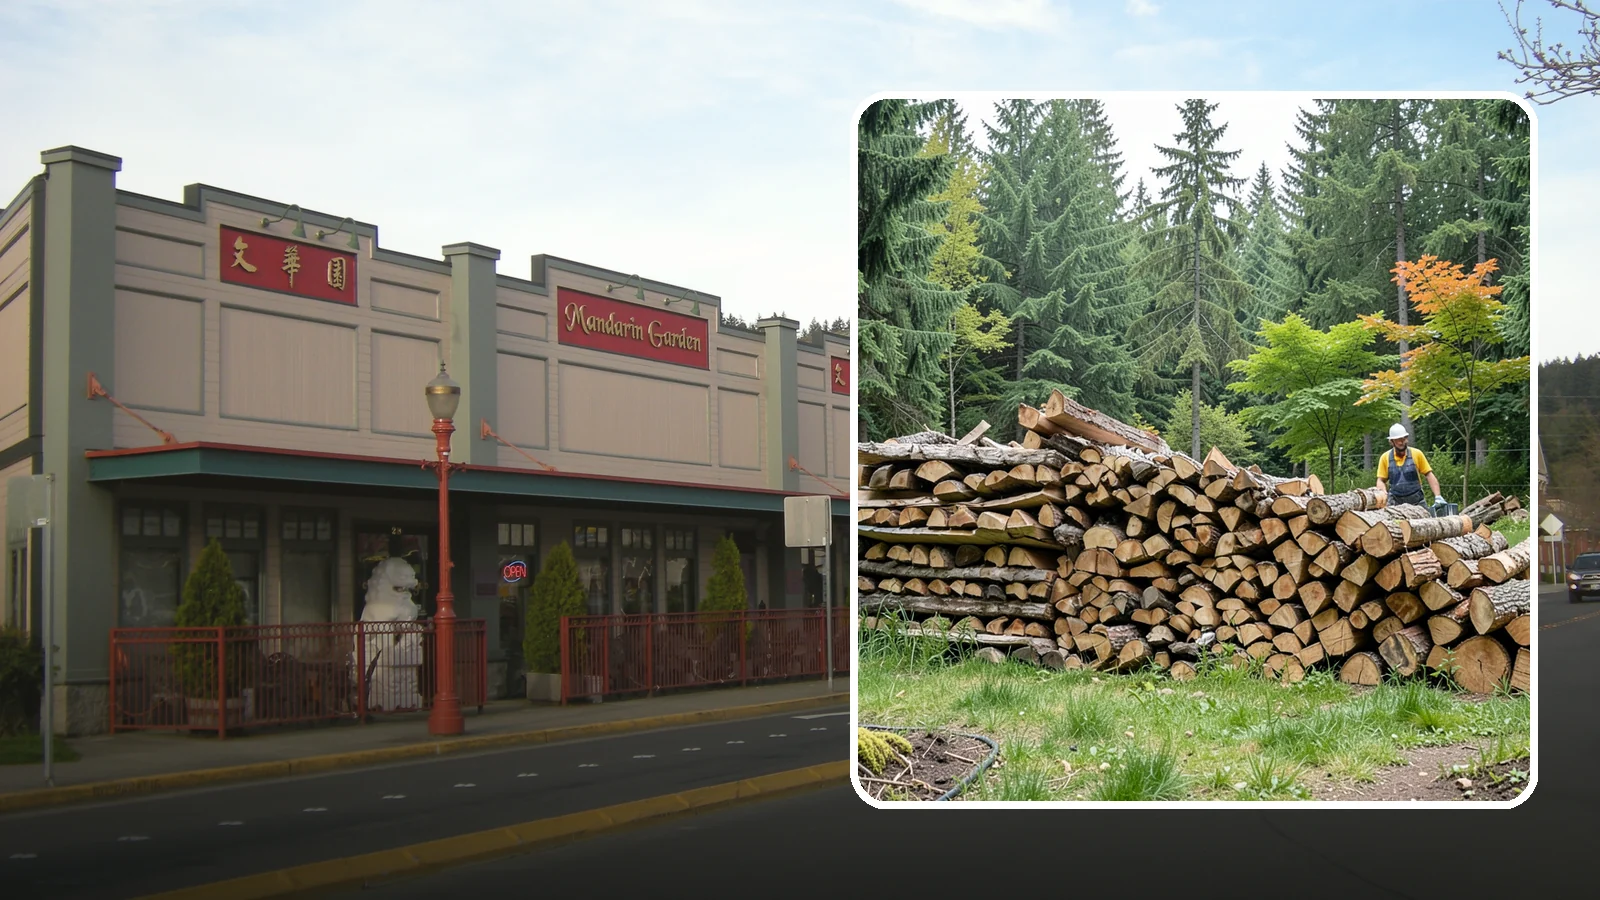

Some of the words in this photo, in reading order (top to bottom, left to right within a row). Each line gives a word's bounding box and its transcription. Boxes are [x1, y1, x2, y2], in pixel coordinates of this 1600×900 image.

[230, 235, 346, 291] 文華園
[564, 302, 644, 341] Mandarin
[648, 320, 701, 352] Garden
[503, 565, 527, 578] OPEN
